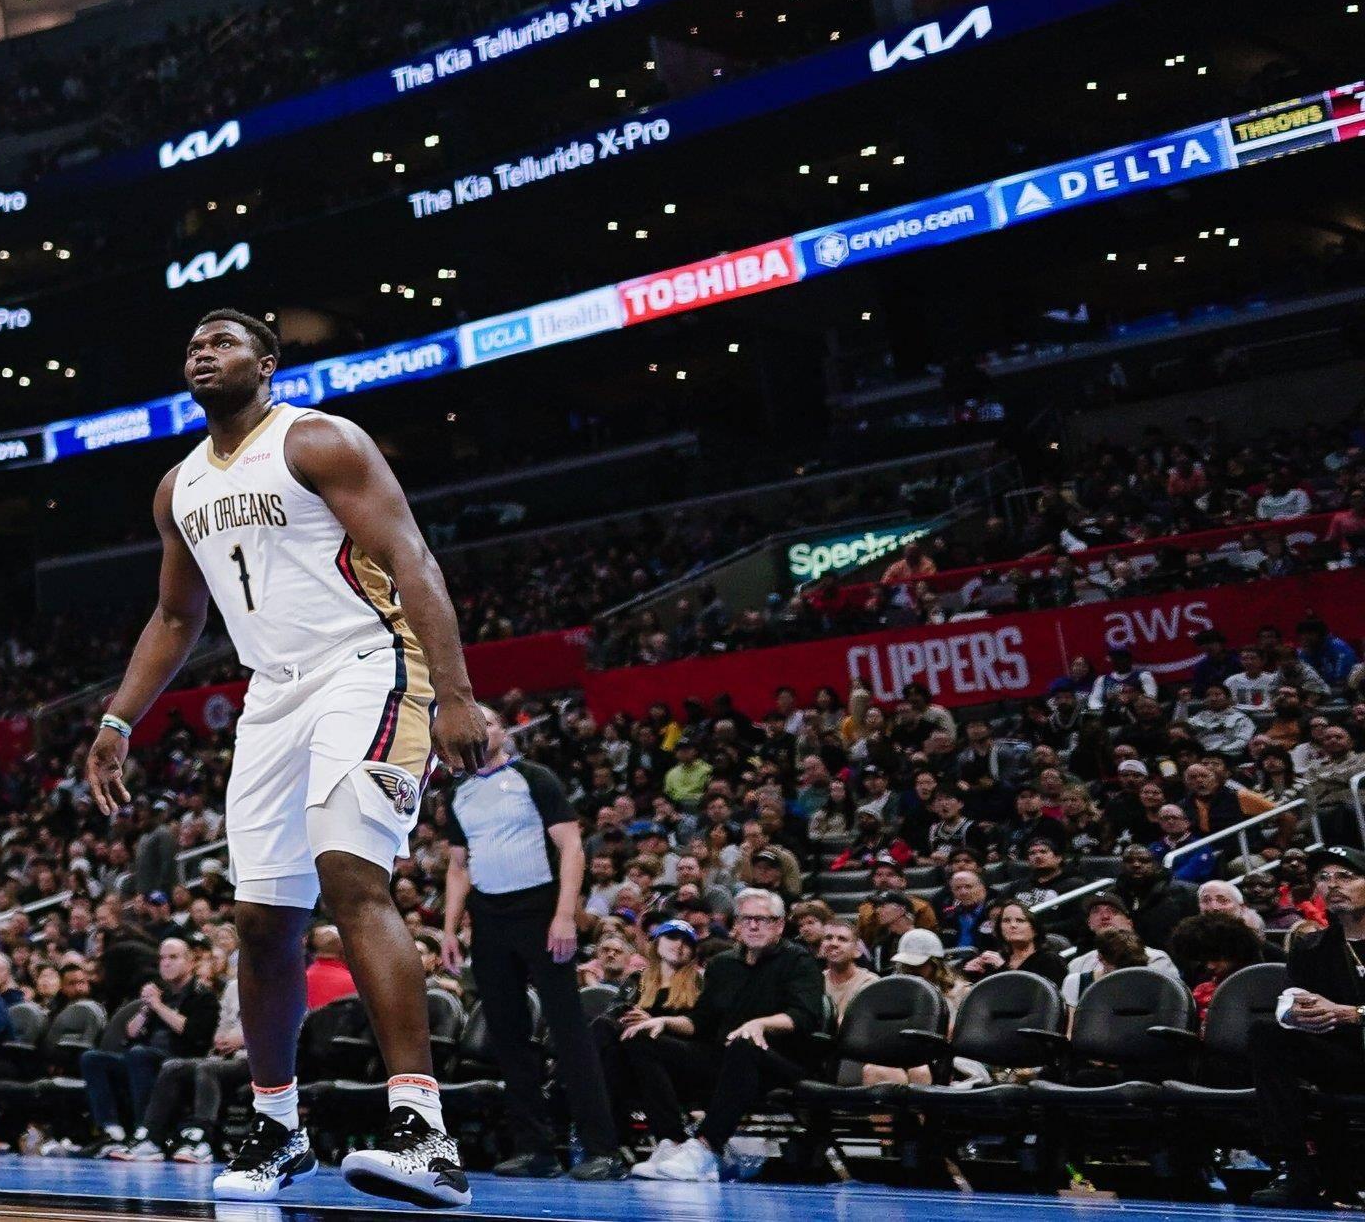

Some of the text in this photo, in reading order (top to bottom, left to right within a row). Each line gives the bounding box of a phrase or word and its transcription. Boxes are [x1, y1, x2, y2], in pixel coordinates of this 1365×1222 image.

[391, 62, 435, 92] The
[435, 48, 473, 78] Kia
[473, 11, 570, 62] Telluride
[1235, 105, 1324, 141] THROWS
[408, 118, 670, 218] The Kia Telluride X-Pro
[1058, 135, 1213, 202] DELTA
[848, 201, 976, 256] crypto.com
[623, 248, 791, 319] TOSHIBA
[327, 340, 444, 392] Spectrum
[477, 324, 527, 353] UCLA
[271, 377, 312, 403] TRA
[242, 451, 272, 466] ibotta
[181, 492, 288, 546] NEW ORLEANS
[229, 543, 256, 615] 1
[846, 599, 1214, 703] CLIPPERS aws
